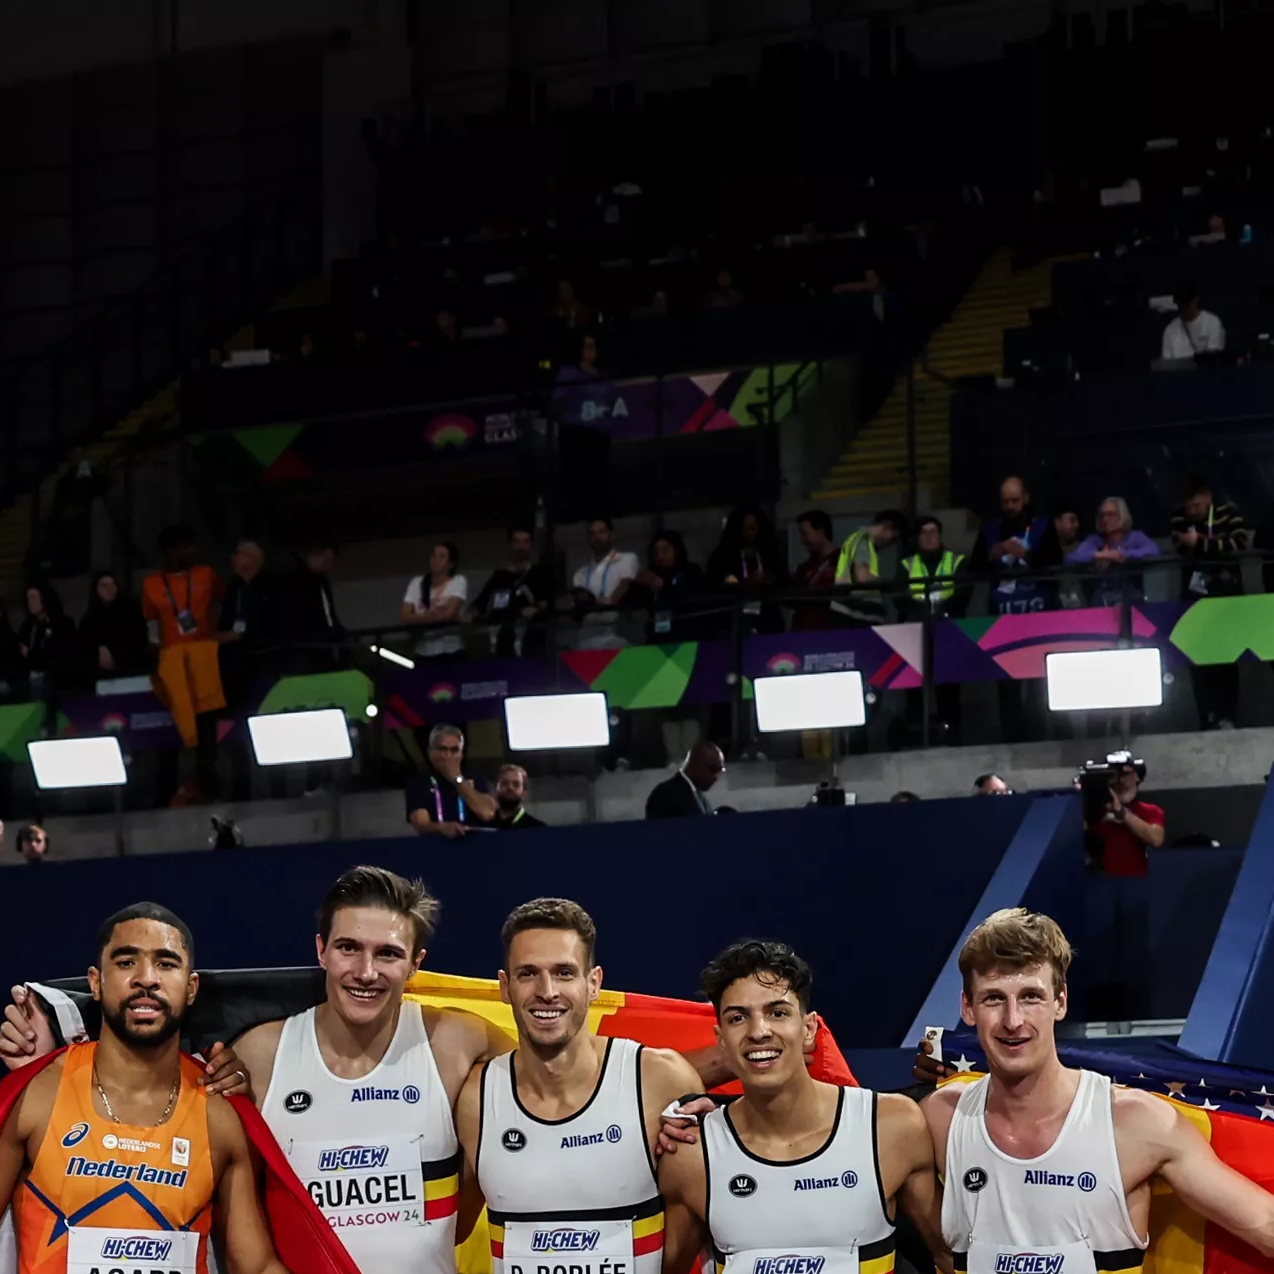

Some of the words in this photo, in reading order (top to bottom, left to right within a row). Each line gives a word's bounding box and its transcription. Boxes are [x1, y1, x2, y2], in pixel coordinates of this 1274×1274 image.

[351, 1087, 400, 1102] Allianz
[560, 1131, 605, 1149] Allianz
[318, 1146, 389, 1171] HI-CHEW
[65, 1156, 187, 1188] Nederland
[1024, 1170, 1075, 1187] Allianz
[304, 1174, 416, 1208] GUACEL
[793, 1176, 839, 1191] Allianz
[327, 1211, 401, 1228] GLASGOW
[404, 1209, 419, 1221] 24
[100, 1236, 173, 1262] HI-CHEW
[531, 1229, 600, 1252] HI-CHEW
